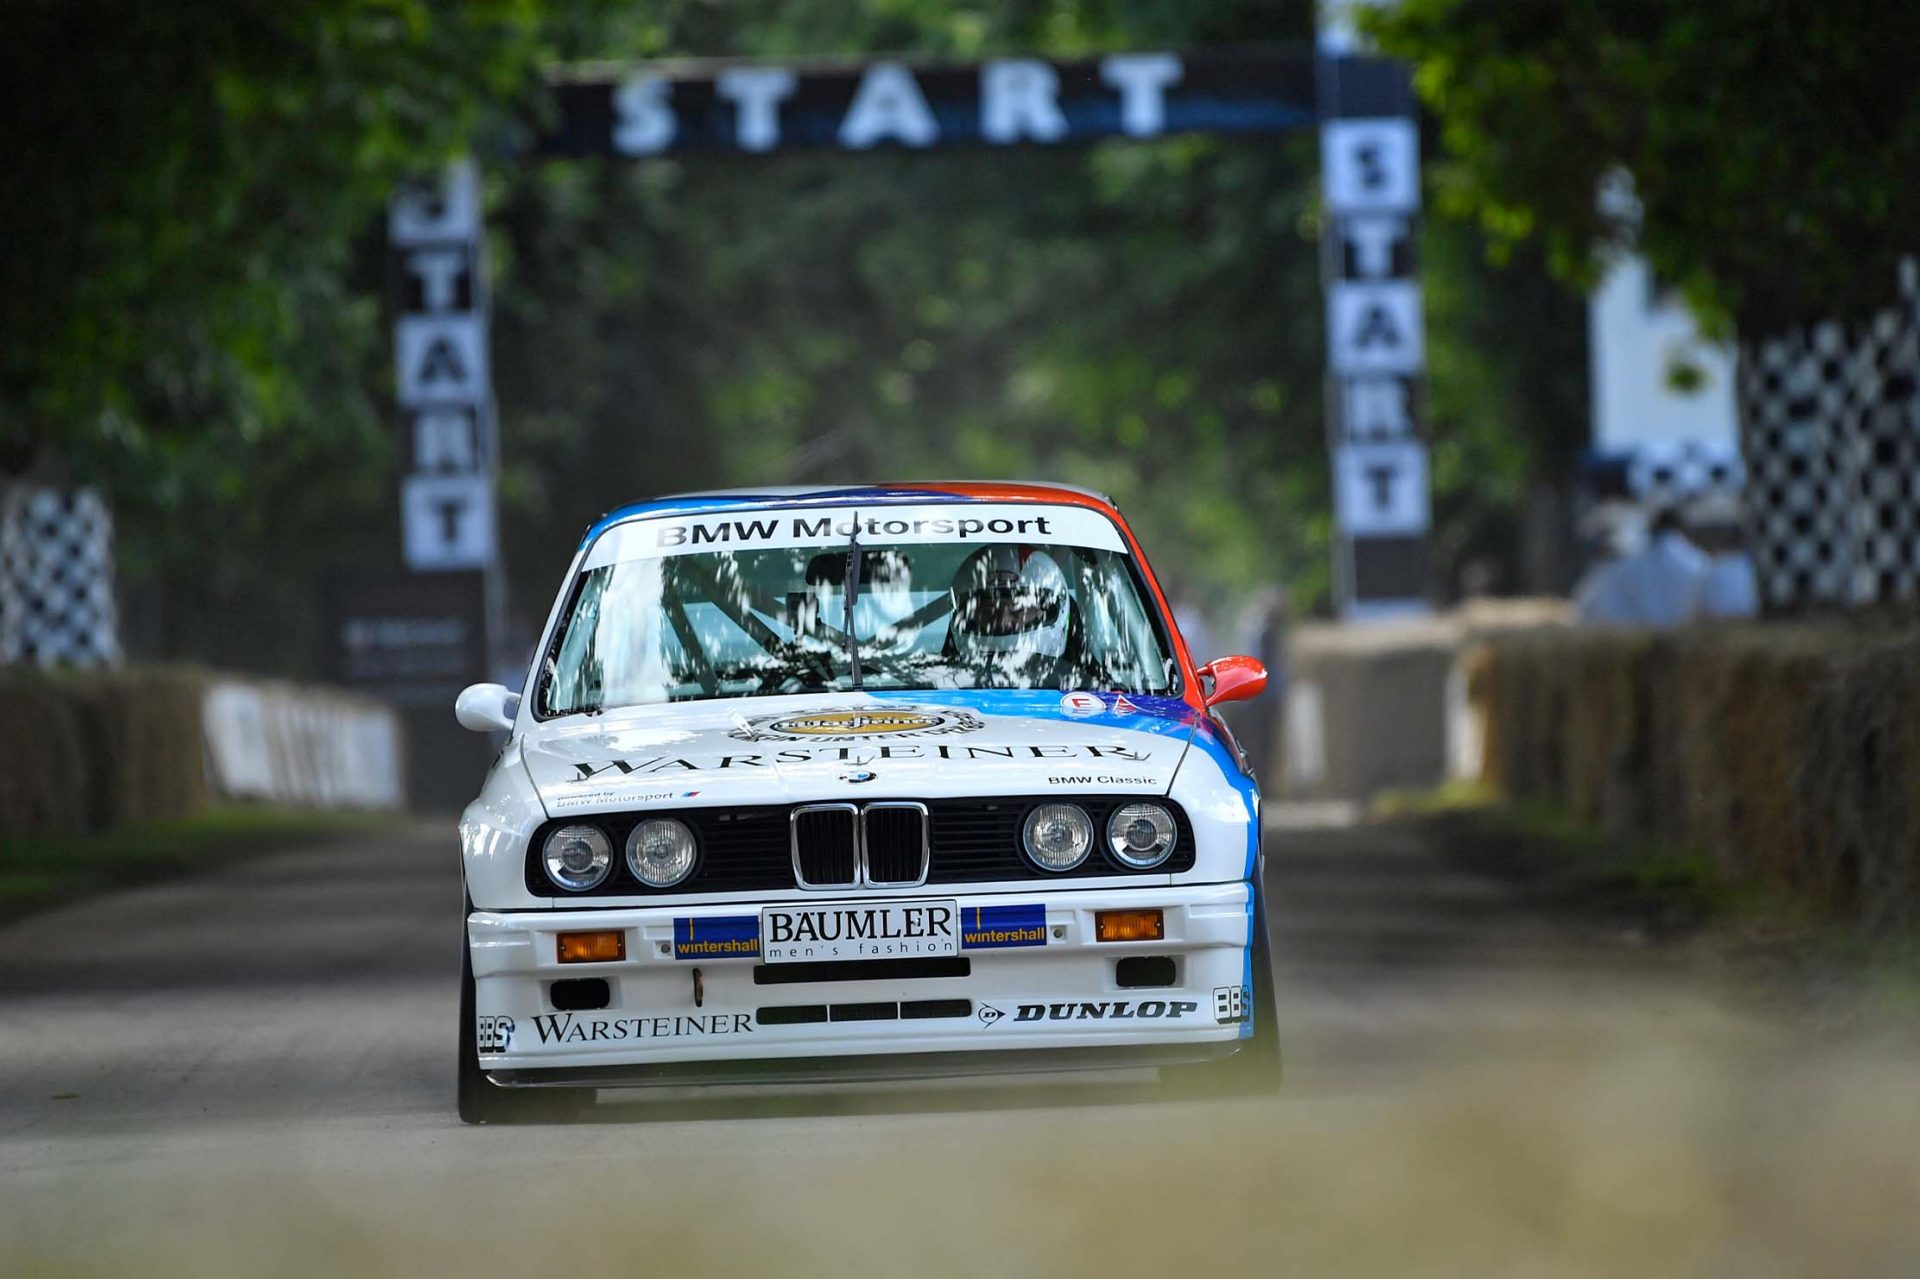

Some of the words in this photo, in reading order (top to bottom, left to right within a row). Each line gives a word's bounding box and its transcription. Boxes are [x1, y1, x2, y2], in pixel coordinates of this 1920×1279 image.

[612, 55, 1184, 155] START
[656, 519, 779, 548] BMW
[792, 515, 1053, 539] Motorsport
[566, 745, 1138, 780] WARSTEINER
[1048, 776, 1092, 785] BMW
[1097, 776, 1158, 785] Classic
[768, 907, 951, 942] BÄUMLER
[964, 927, 1045, 943] wintershall
[678, 939, 759, 953] wintershall
[768, 944, 839, 958] men's
[858, 941, 953, 953] fashion
[1013, 1001, 1198, 1021] DUNLOP
[1212, 985, 1250, 1024] BBS
[478, 1015, 516, 1053] BBS
